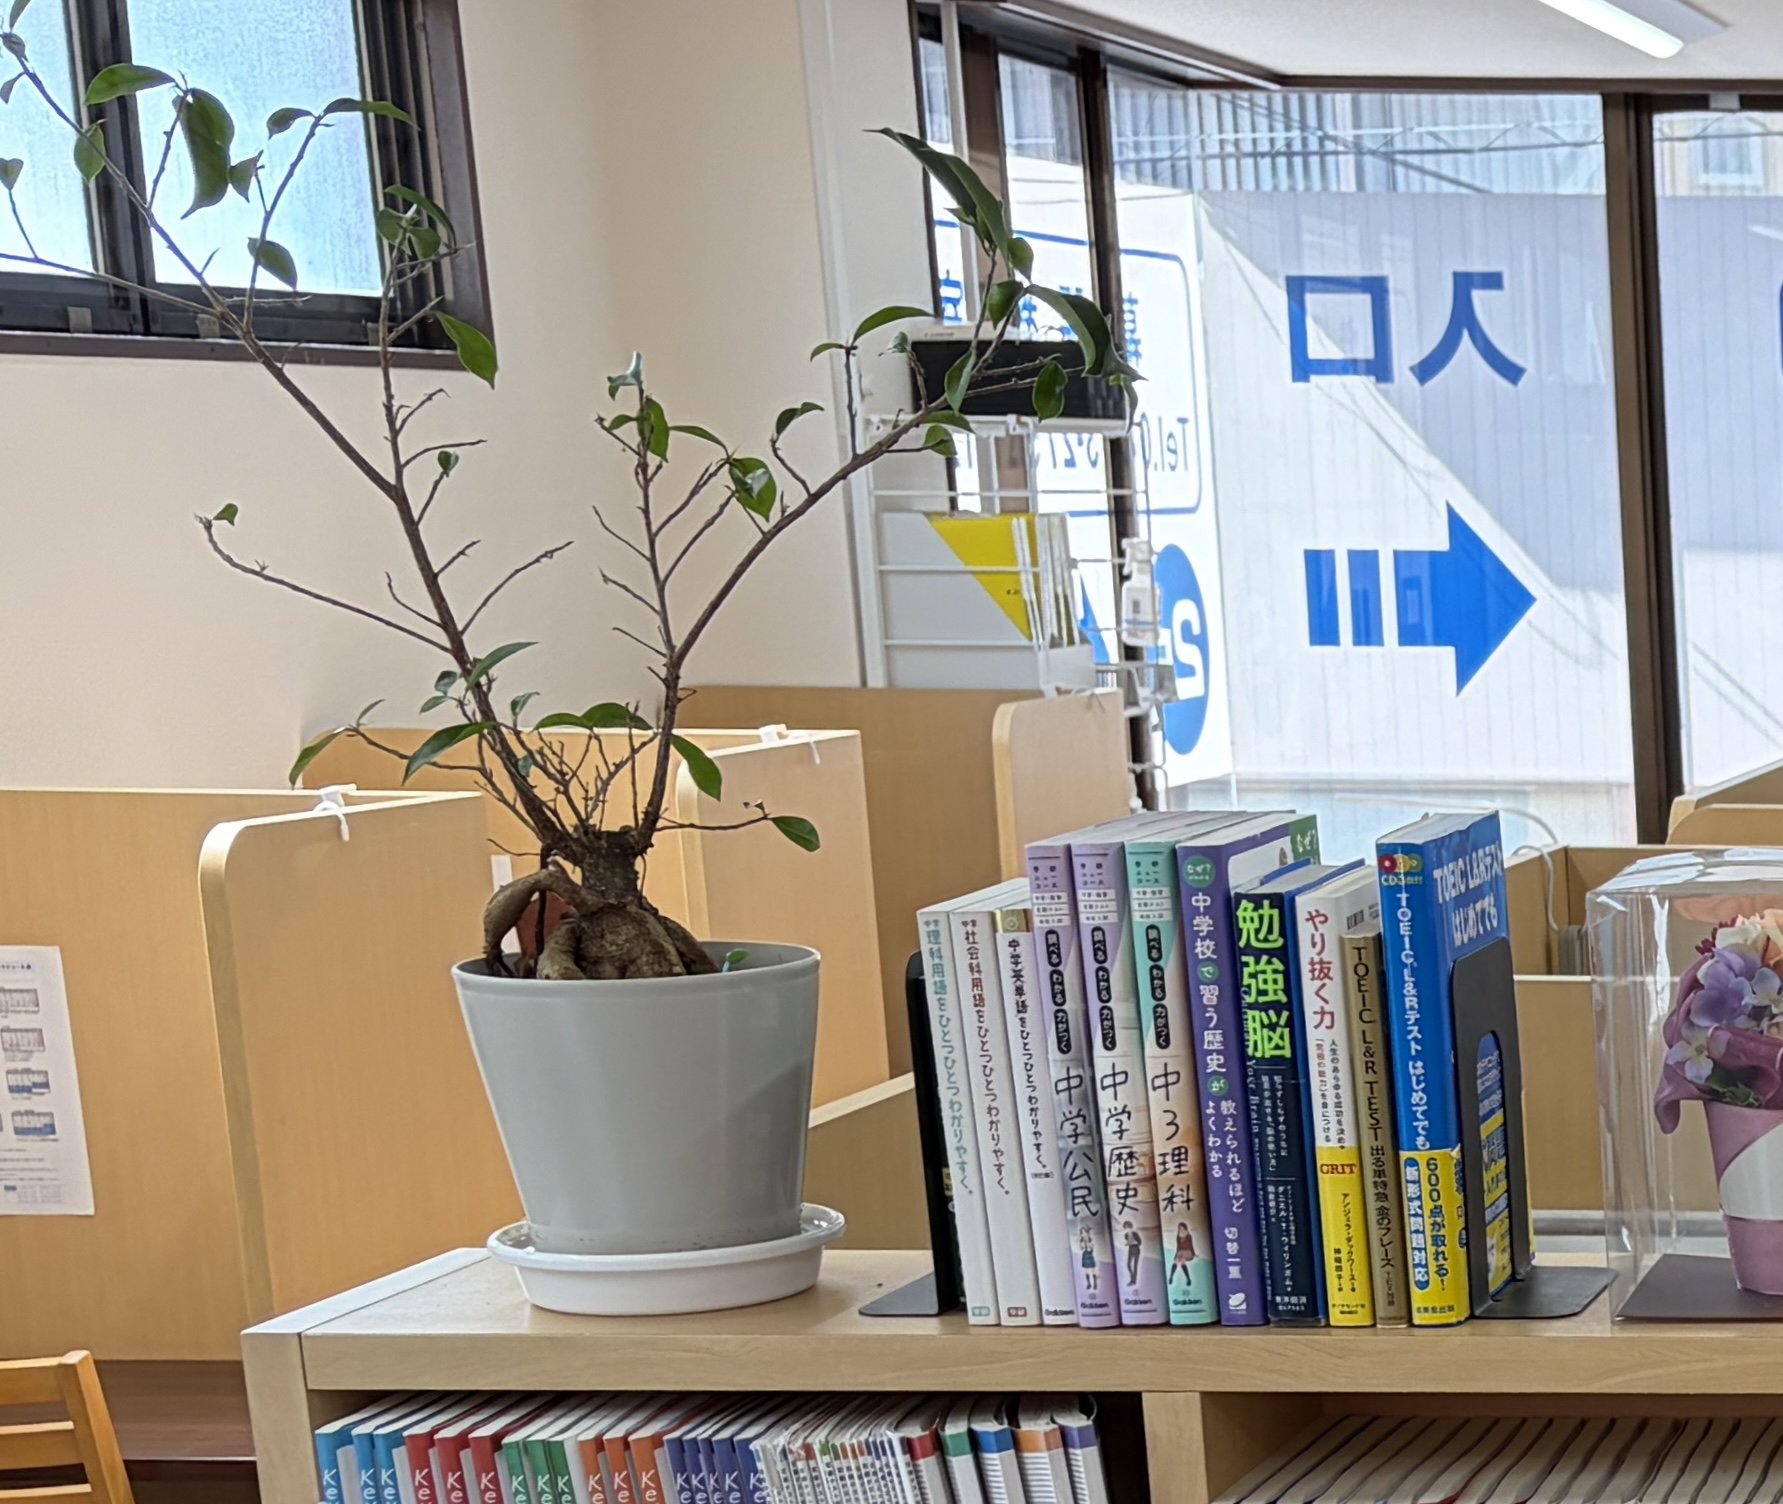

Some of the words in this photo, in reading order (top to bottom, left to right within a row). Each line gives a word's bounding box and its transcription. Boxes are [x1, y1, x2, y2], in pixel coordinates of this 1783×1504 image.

[1236, 899, 1292, 1059] 勉強脳
[1304, 908, 1336, 1030] やり抜く力
[1352, 946, 1376, 1024] TOEIC
[1362, 1032, 1378, 1075] L&R
[1054, 1064, 1100, 1217] 中学公民
[1100, 1061, 1142, 1215] 中学歴史
[1150, 1062, 1196, 1213] 中3理科
[1206, 1100, 1223, 1178] よくわかる
[1366, 1081, 1383, 1142] TEST
[1407, 1062, 1431, 1150] はじめてでも
[1220, 1100, 1245, 1213] 教えられるほど
[1320, 1164, 1356, 1175] GRIT
[1376, 1205, 1395, 1268] 金のフレーズ
